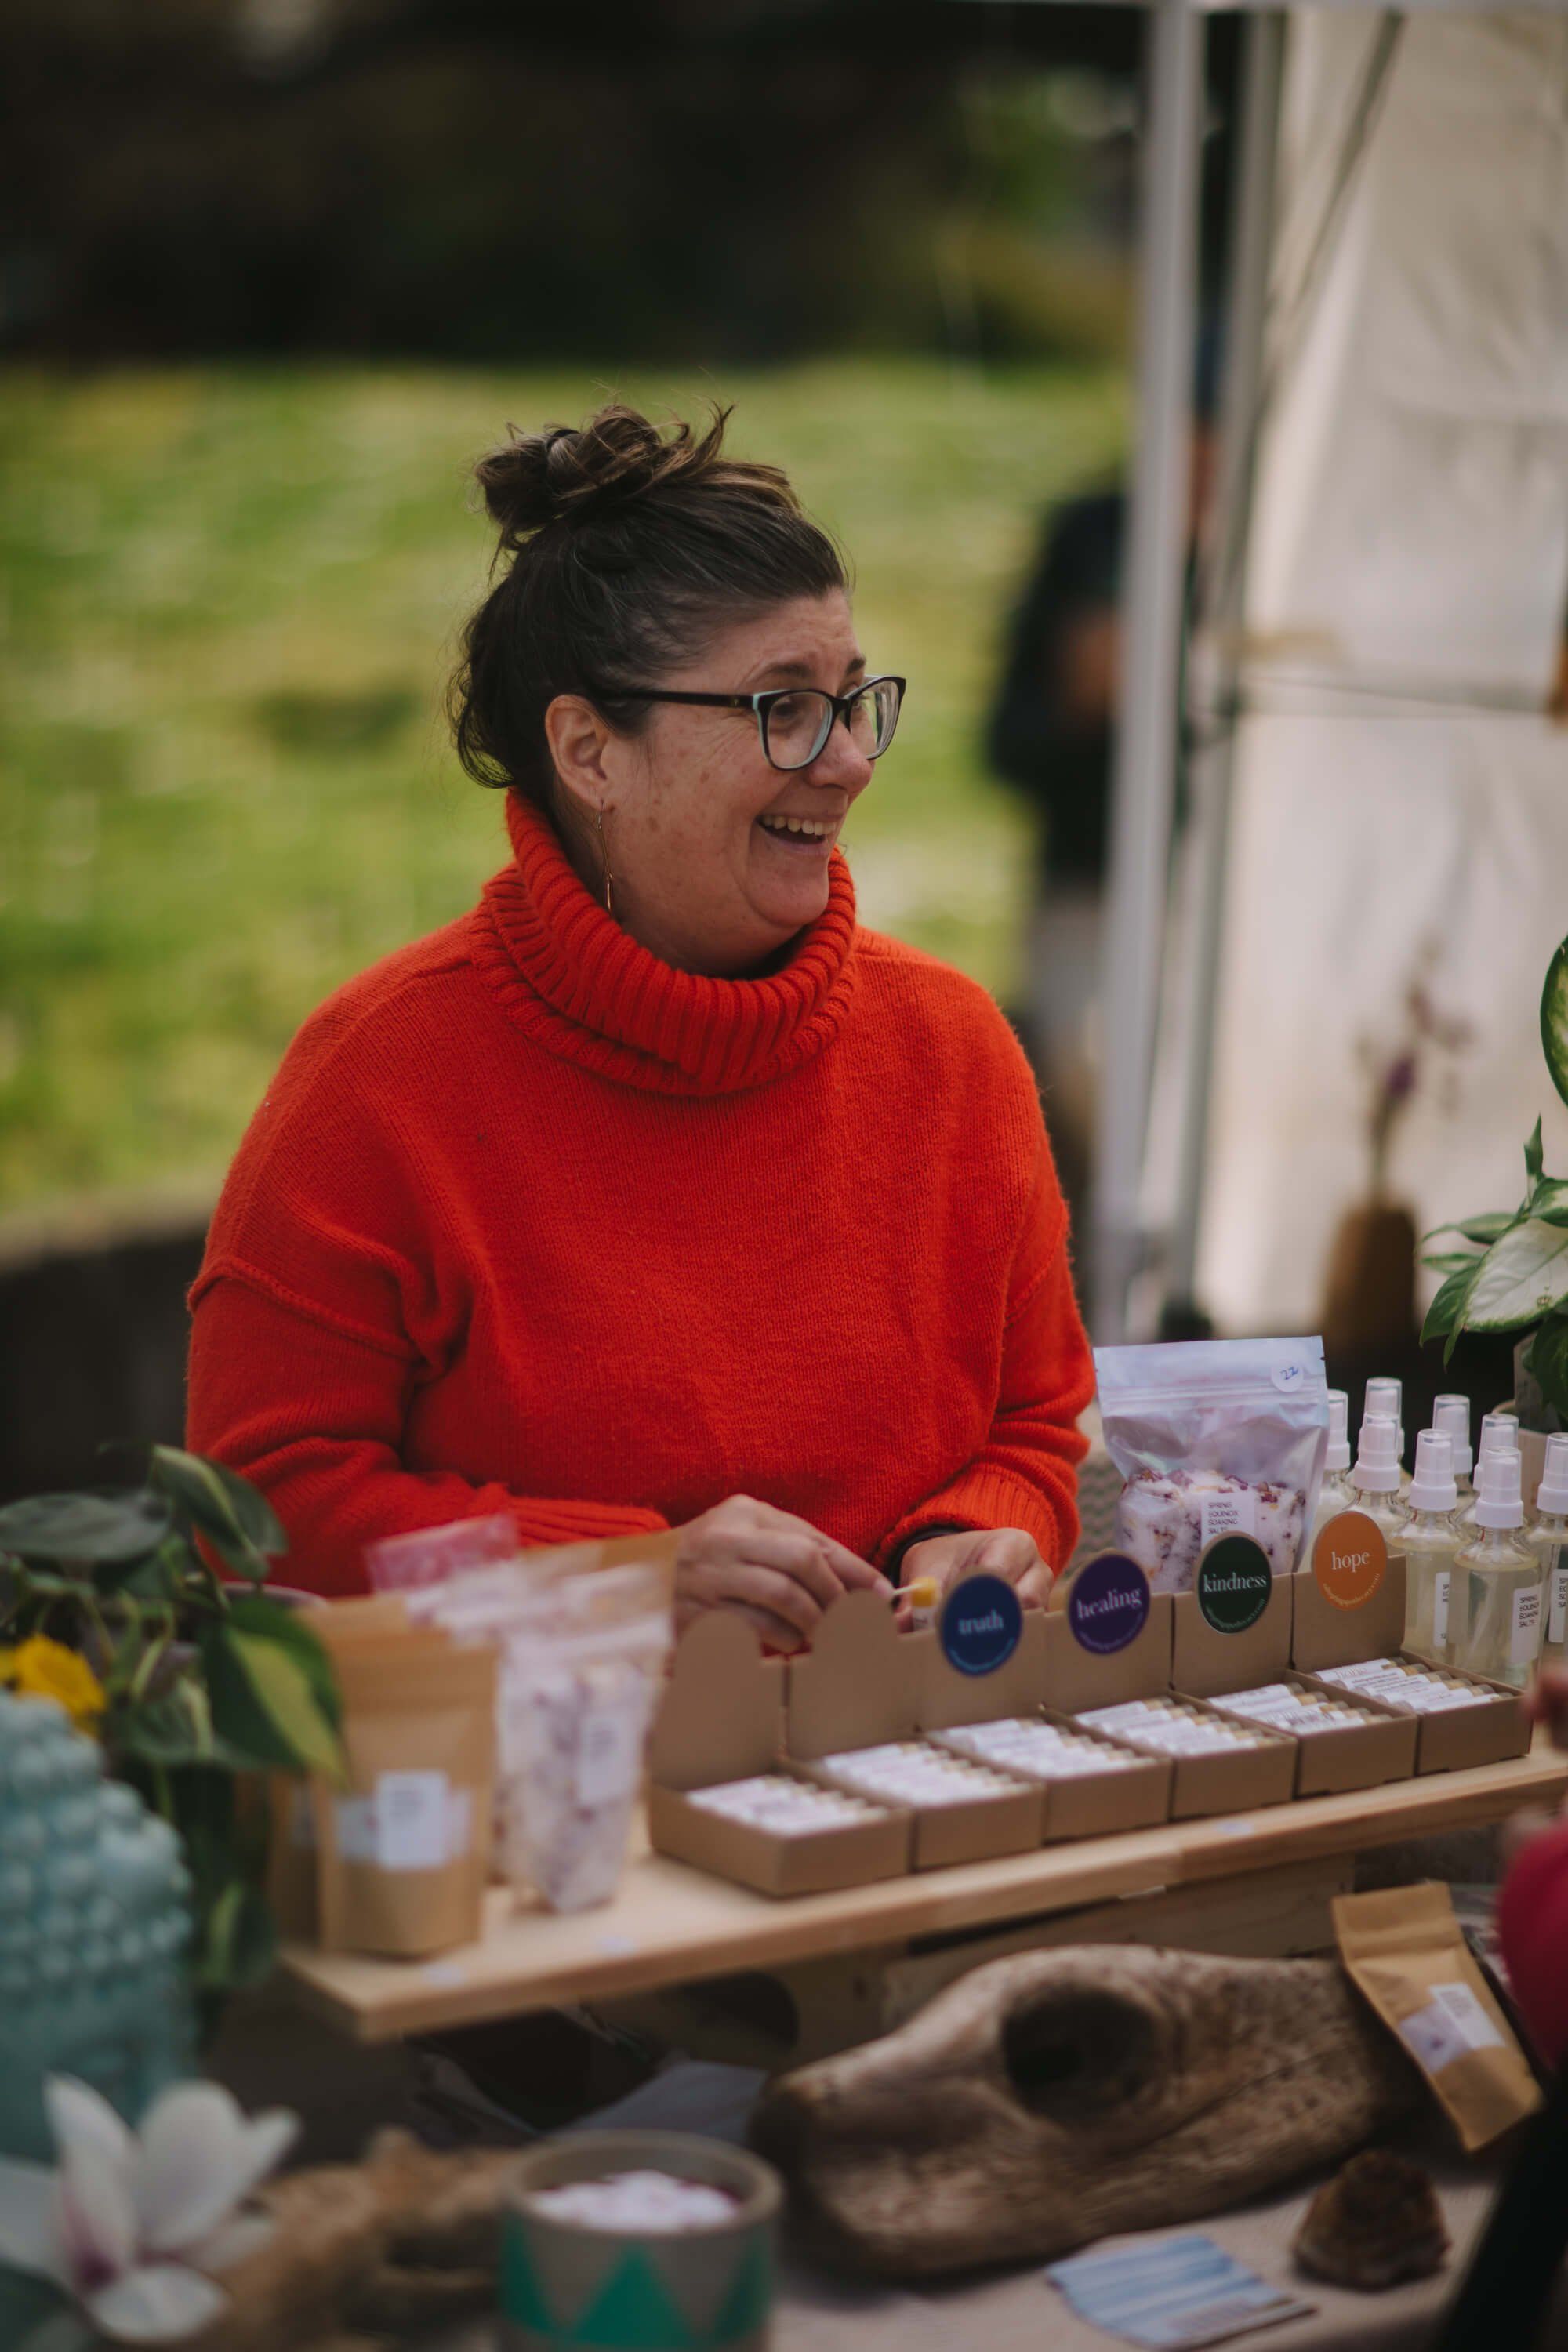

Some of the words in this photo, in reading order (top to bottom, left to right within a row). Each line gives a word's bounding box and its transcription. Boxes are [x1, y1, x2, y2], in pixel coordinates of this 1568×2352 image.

[1208, 1509, 1239, 1518] EQUINOX
[1208, 1517, 1239, 1526] SOAKING
[1330, 1551, 1370, 1573] hope
[1203, 1571, 1267, 1592] kindness
[1076, 1587, 1142, 1621] healing
[957, 1607, 1004, 1635] truth
